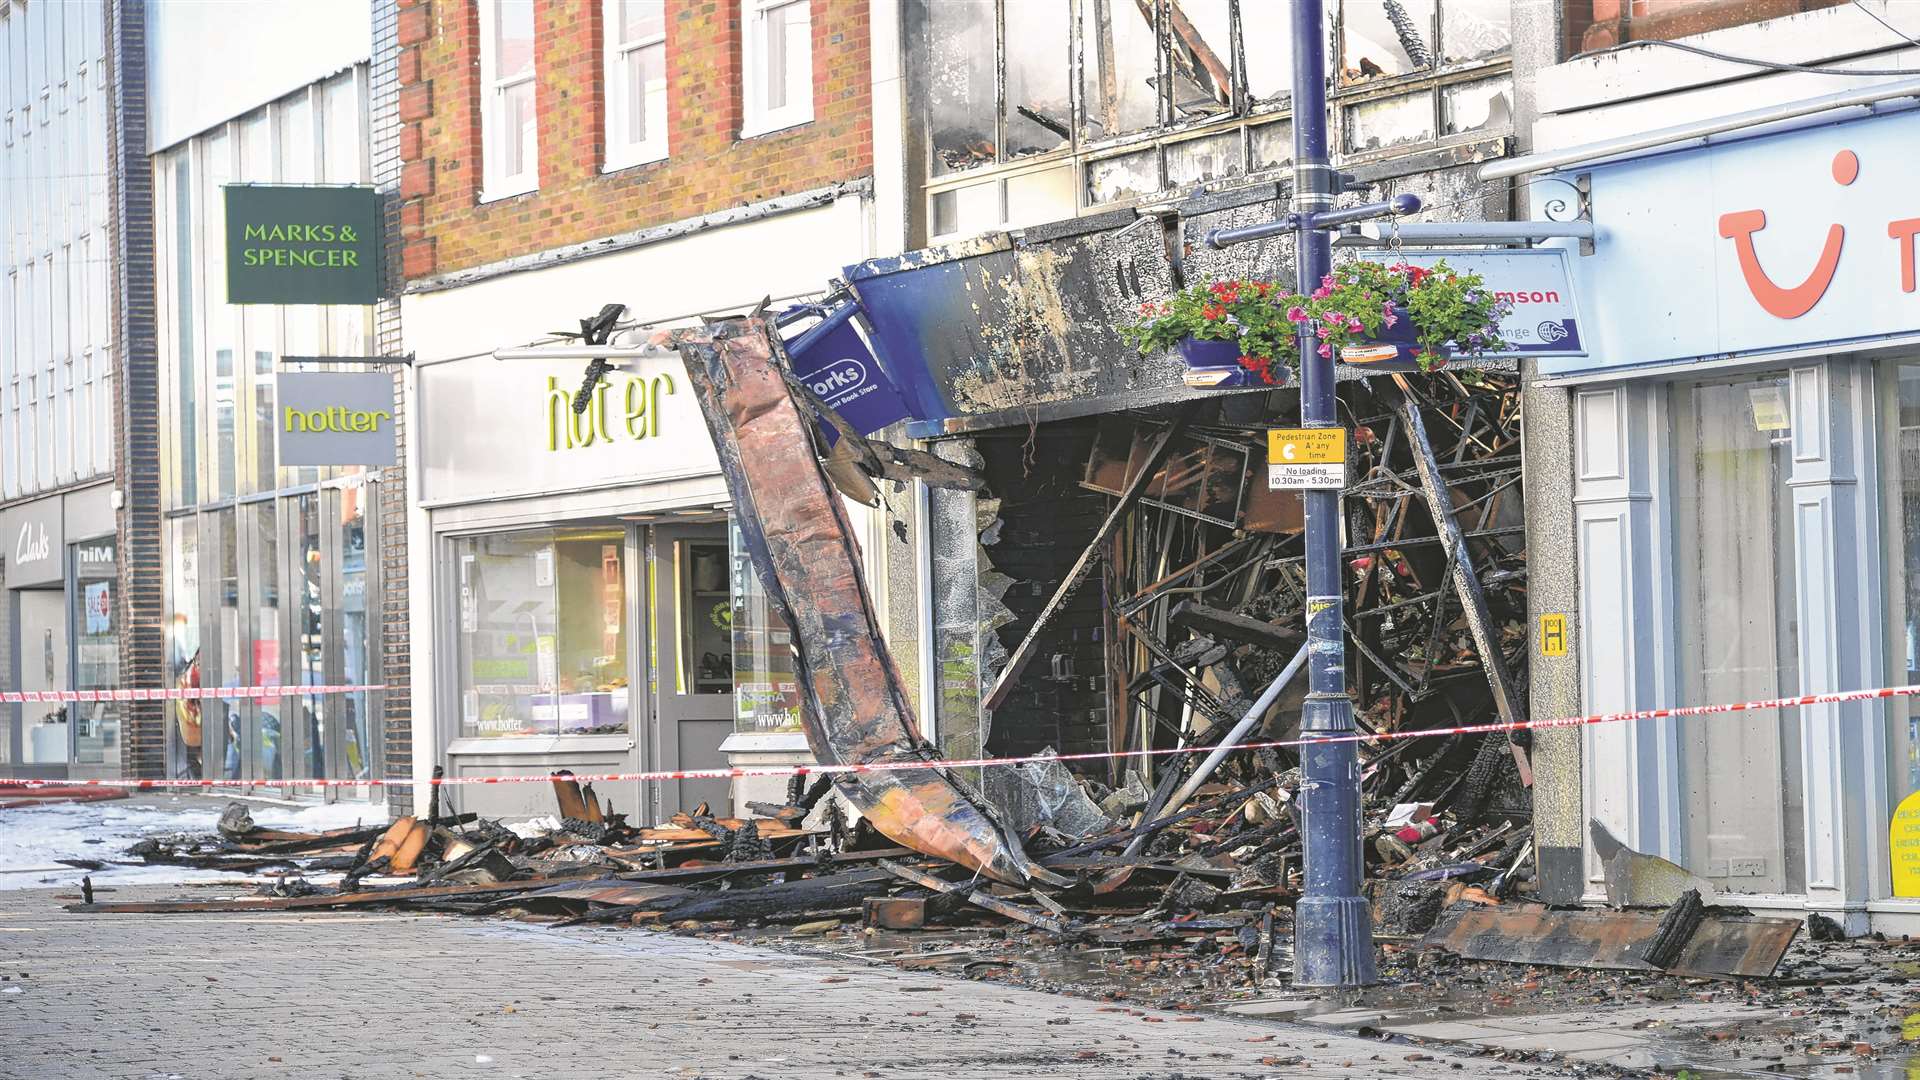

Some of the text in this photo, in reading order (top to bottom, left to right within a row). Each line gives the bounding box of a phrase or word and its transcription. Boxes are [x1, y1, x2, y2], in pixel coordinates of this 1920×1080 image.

[244, 223, 357, 242] MARKS &
[243, 248, 359, 267] SPENCER
[1493, 290, 1560, 304] mson
[808, 367, 860, 396] orks
[840, 391, 861, 405] Book
[858, 383, 879, 397] Store
[284, 406, 391, 433] hotter
[1276, 432, 1337, 441] Pedestrian Zone
[1316, 442, 1330, 450] any
[1286, 467, 1327, 476] No loading
[1271, 477, 1305, 485] 10.30am
[1311, 476, 1342, 486] 5.30pm
